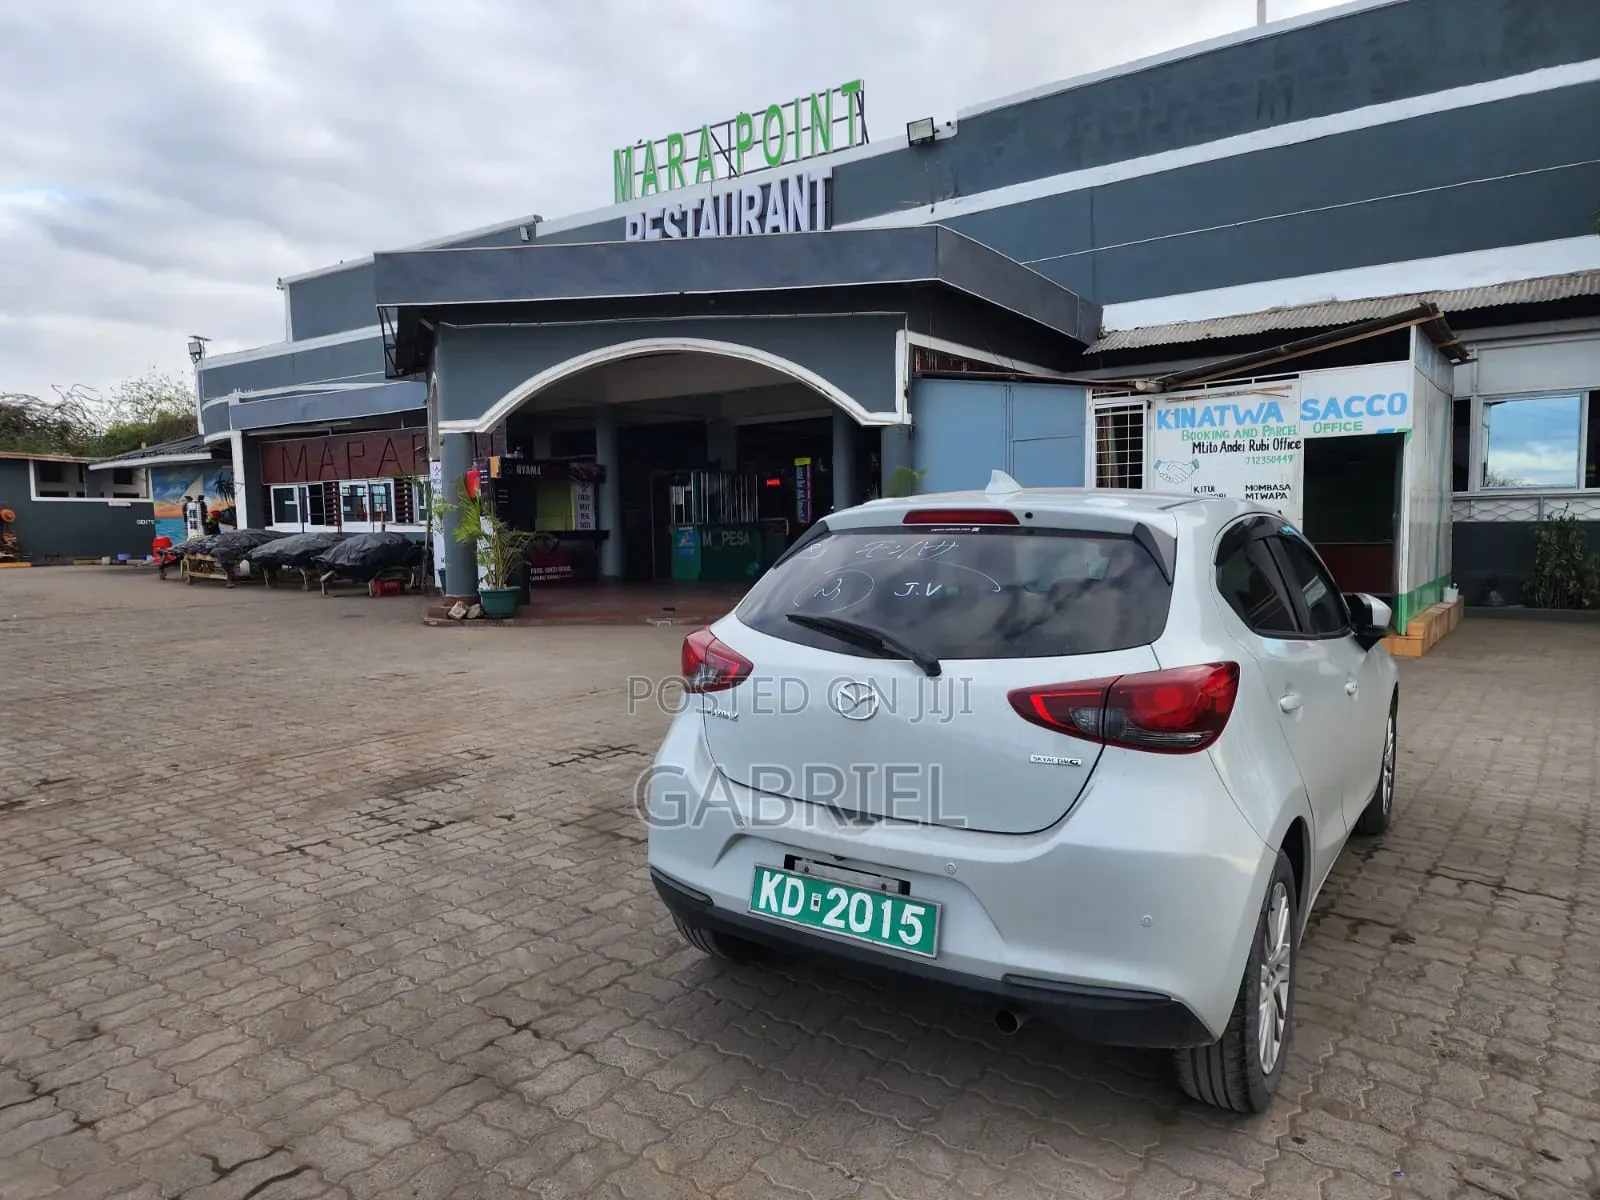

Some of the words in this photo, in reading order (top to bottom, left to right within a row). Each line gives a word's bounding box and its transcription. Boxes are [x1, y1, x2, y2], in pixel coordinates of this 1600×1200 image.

[613, 124, 716, 205] MARA
[735, 79, 864, 176] POINT
[625, 166, 832, 241] RESTAURANT
[1157, 401, 1284, 430] KINATWA
[1300, 392, 1408, 421] SACCO
[1181, 429, 1230, 441] BOOKING
[1233, 428, 1258, 438] AND
[1262, 424, 1298, 437] PARCEL
[1312, 421, 1363, 434] OFFICE
[1219, 440, 1245, 453] Andei
[1249, 438, 1270, 452] Rubi
[1272, 437, 1302, 451] Office
[516, 464, 542, 475] NYAMA
[1245, 483, 1292, 492] MOMBASA
[1245, 492, 1288, 500] MTWAPA
[722, 530, 751, 547] PESA
[758, 870, 805, 916] KD
[822, 887, 926, 946] 2015
